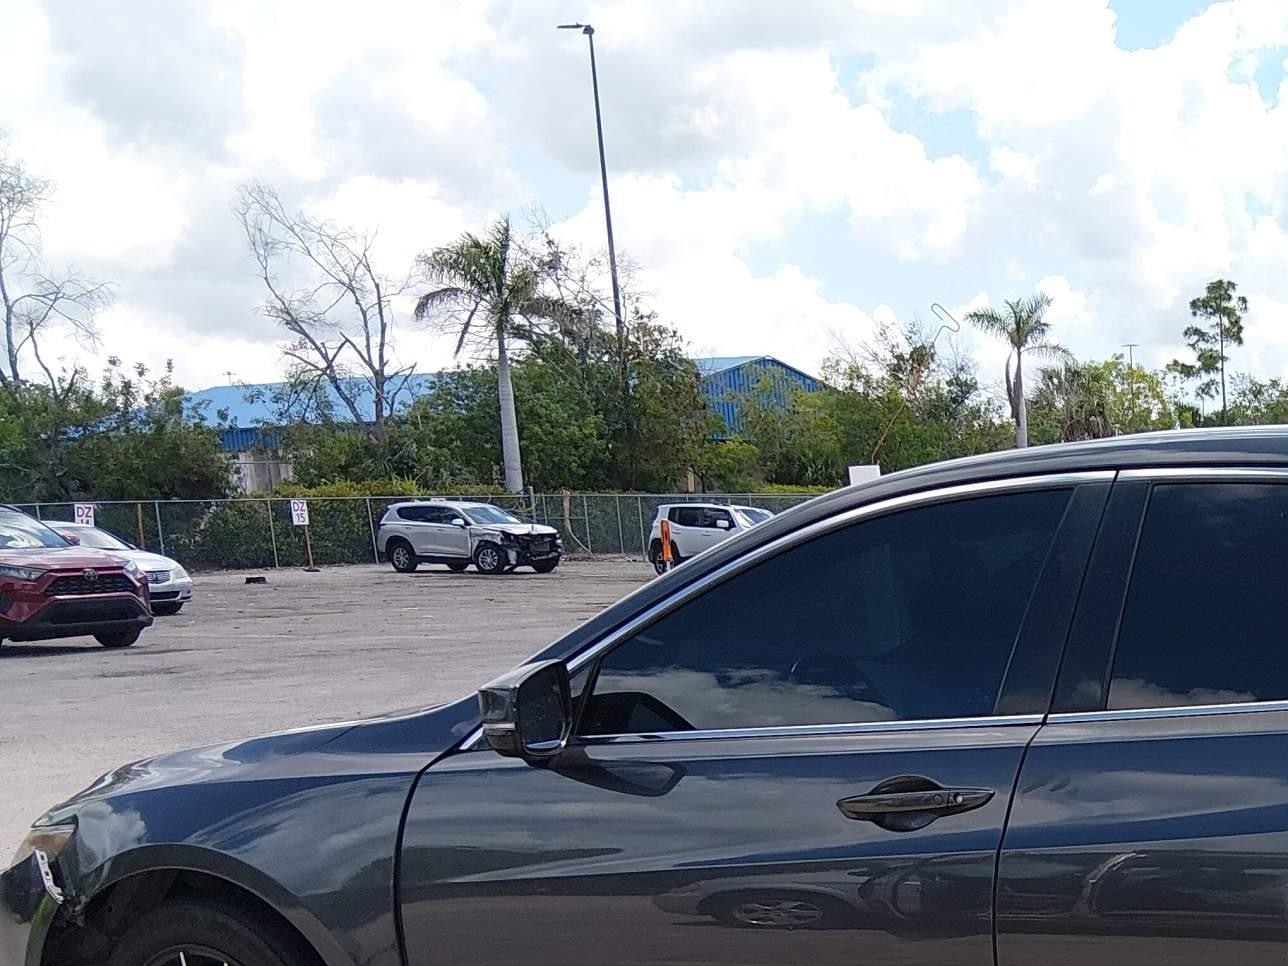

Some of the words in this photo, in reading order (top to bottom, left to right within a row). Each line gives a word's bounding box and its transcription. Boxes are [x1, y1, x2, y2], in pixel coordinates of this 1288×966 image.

[76, 506, 92, 518] DZ
[292, 501, 306, 512] DZ
[296, 513, 306, 523] 15
